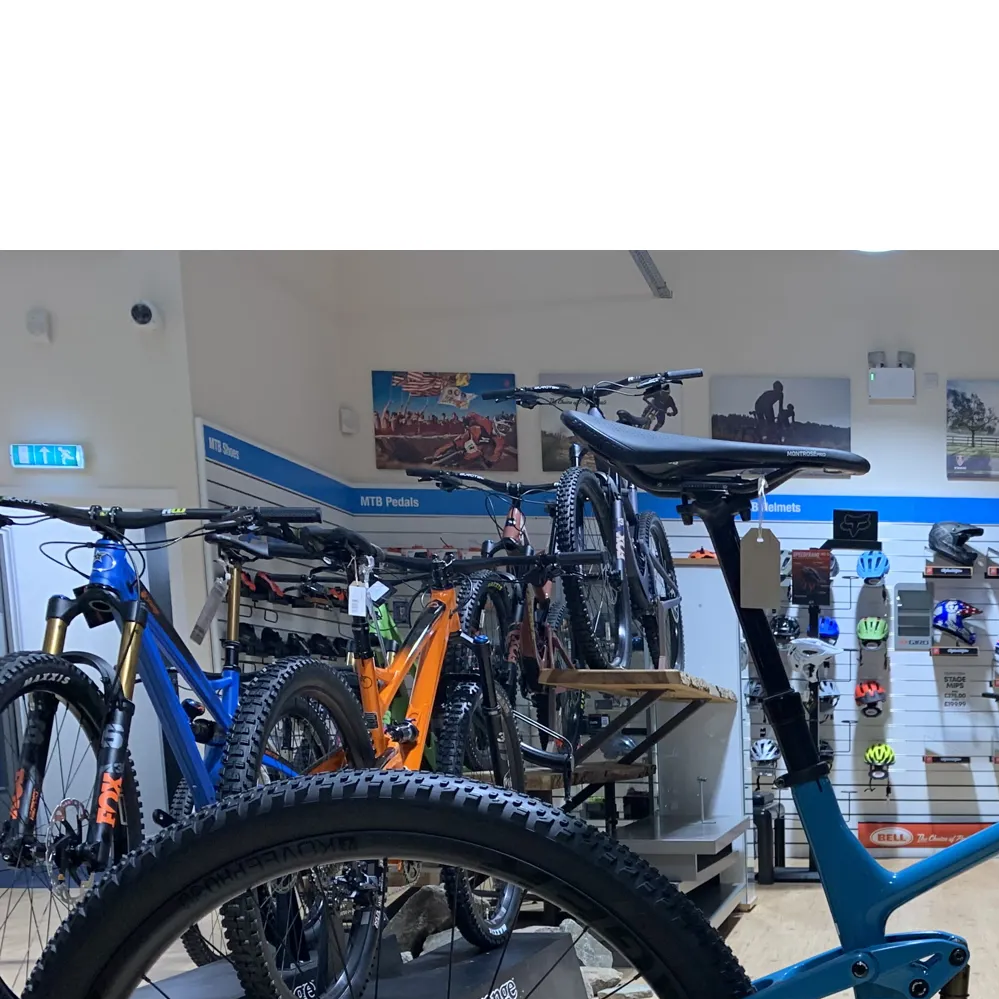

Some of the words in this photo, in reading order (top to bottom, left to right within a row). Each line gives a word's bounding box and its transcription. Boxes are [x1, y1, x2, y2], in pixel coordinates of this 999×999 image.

[208, 437, 222, 453] MTB
[222, 442, 240, 460] Shoes
[360, 496, 383, 507] MTB
[385, 496, 419, 508] Pedals
[23, 672, 71, 687] MAXXIS
[96, 771, 123, 828] FOX
[877, 833, 907, 842] BELL
[917, 833, 929, 843] The
